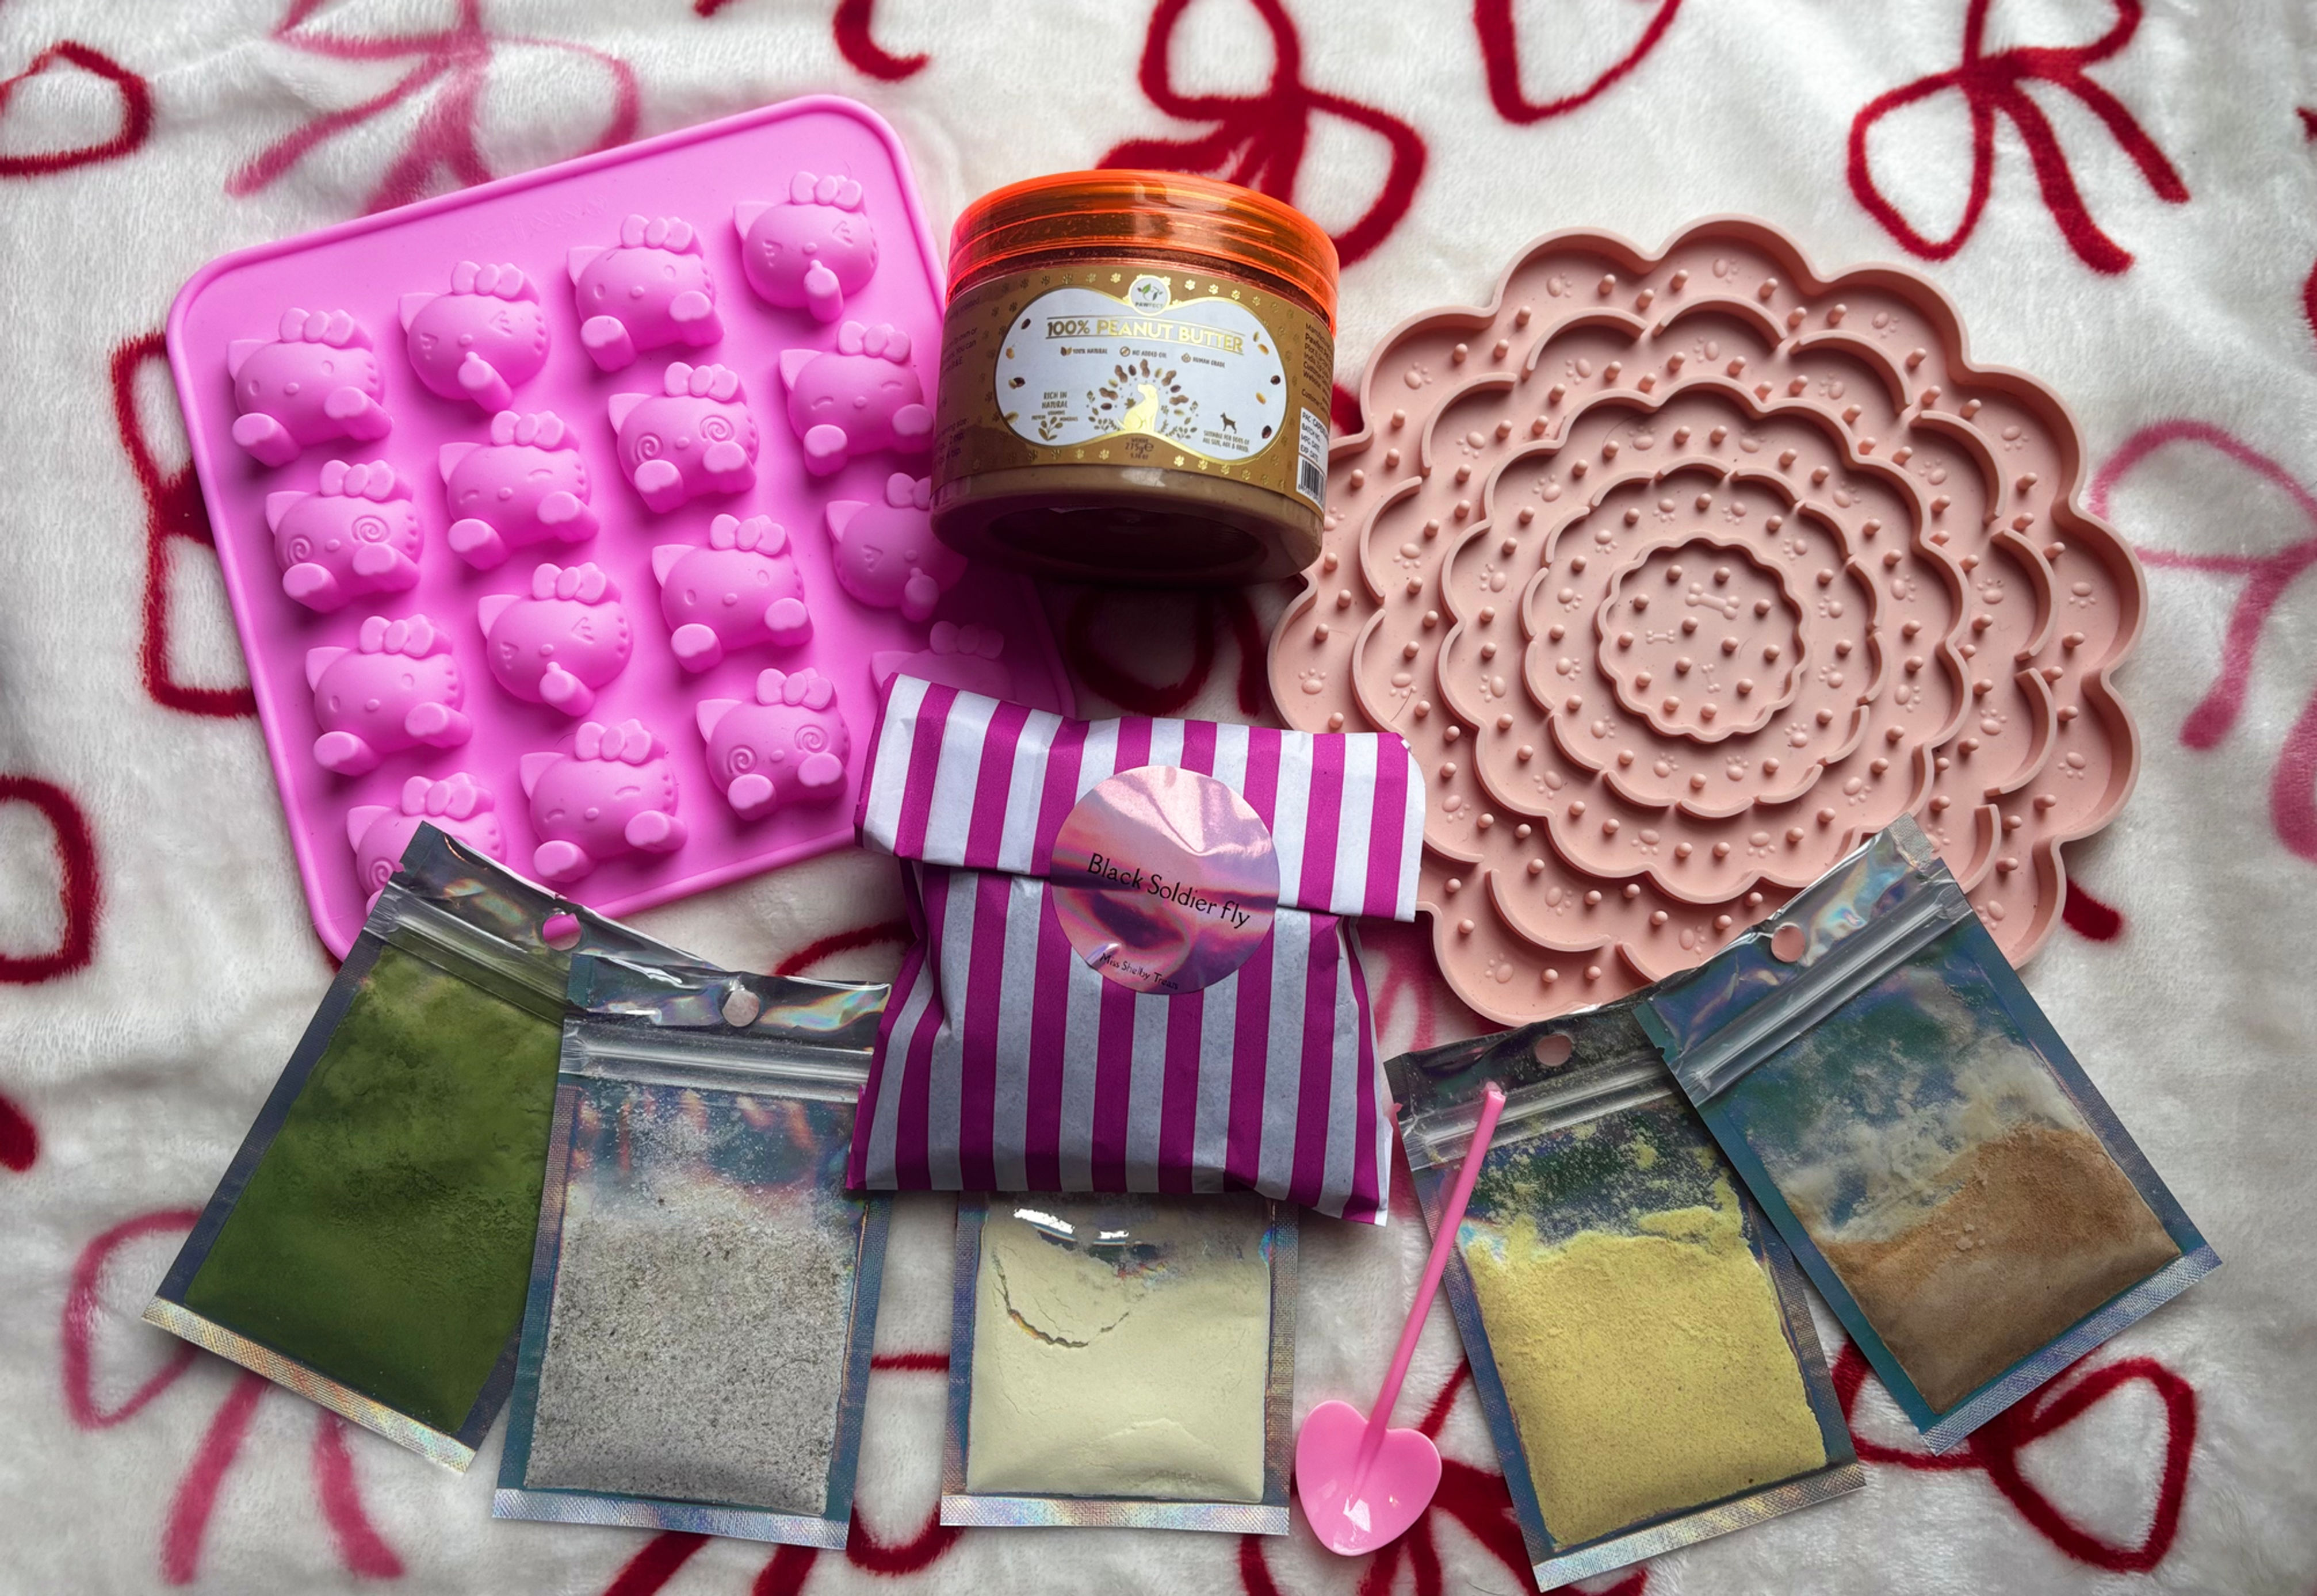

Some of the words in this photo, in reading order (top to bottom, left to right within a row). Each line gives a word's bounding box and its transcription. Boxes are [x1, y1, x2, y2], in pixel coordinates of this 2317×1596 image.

[1047, 320, 1090, 336] 100%
[1096, 320, 1173, 339] PEANUT
[1179, 326, 1243, 353] BUTTER
[1211, 359, 1225, 369] GRADE
[1042, 400, 1068, 409] NATURAL
[1043, 391, 1058, 400] RICH
[1087, 852, 1143, 890] Black
[1147, 874, 1217, 915] Soldier
[1220, 901, 1251, 929] fly
[1099, 952, 1120, 968] Miss
[1121, 960, 1150, 980] Shelby
